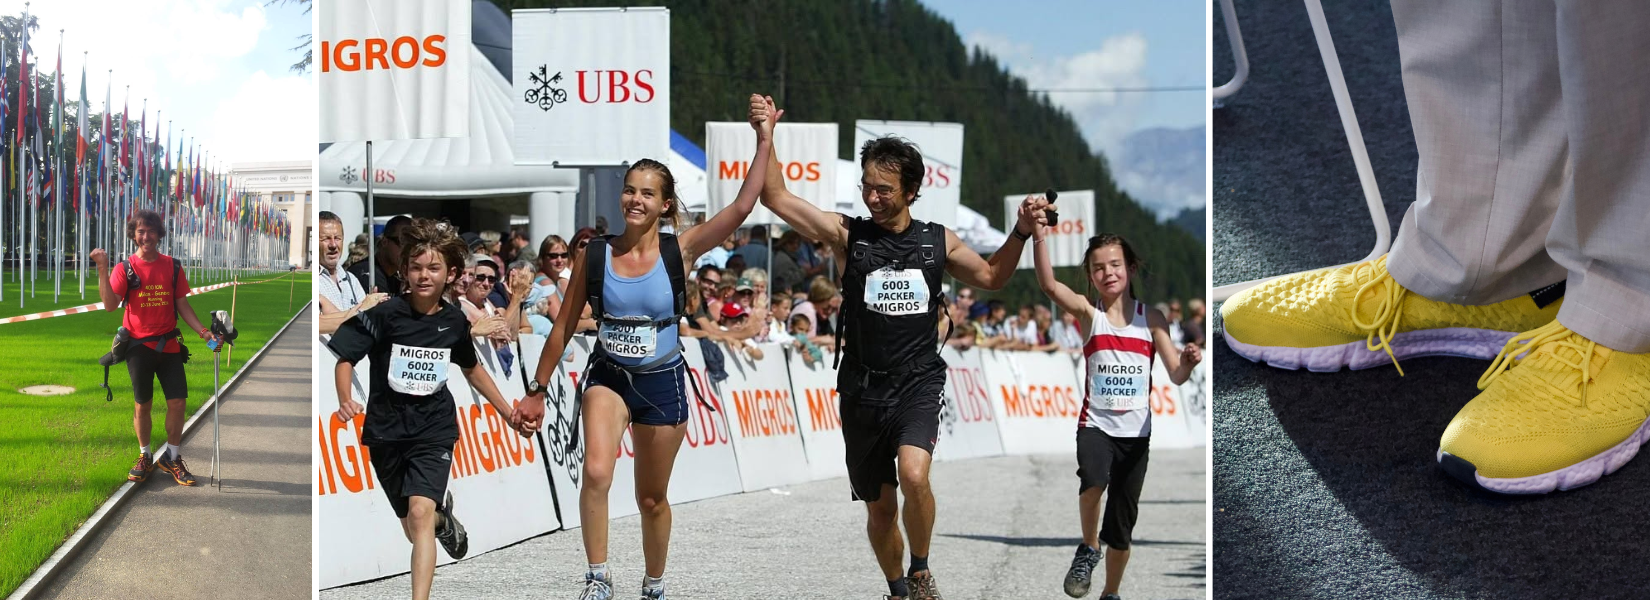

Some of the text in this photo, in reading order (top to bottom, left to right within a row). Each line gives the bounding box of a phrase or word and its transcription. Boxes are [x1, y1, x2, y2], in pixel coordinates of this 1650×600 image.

[575, 69, 656, 104] UBS
[718, 161, 821, 181] MIOS
[882, 280, 910, 290] 6003
[878, 291, 914, 301] PACKER
[873, 301, 920, 312] MIGROS
[608, 332, 642, 344] PACKER
[400, 348, 444, 360] MIGROS
[606, 342, 647, 355] MIGROS
[408, 361, 434, 371] 6002
[1098, 364, 1143, 374] MIGROS
[401, 371, 437, 382] PACKER
[1105, 376, 1133, 386] 6004
[1101, 387, 1137, 396] PACKER
[1001, 384, 1078, 418] MIGROS
[732, 388, 796, 438] MIGROS
